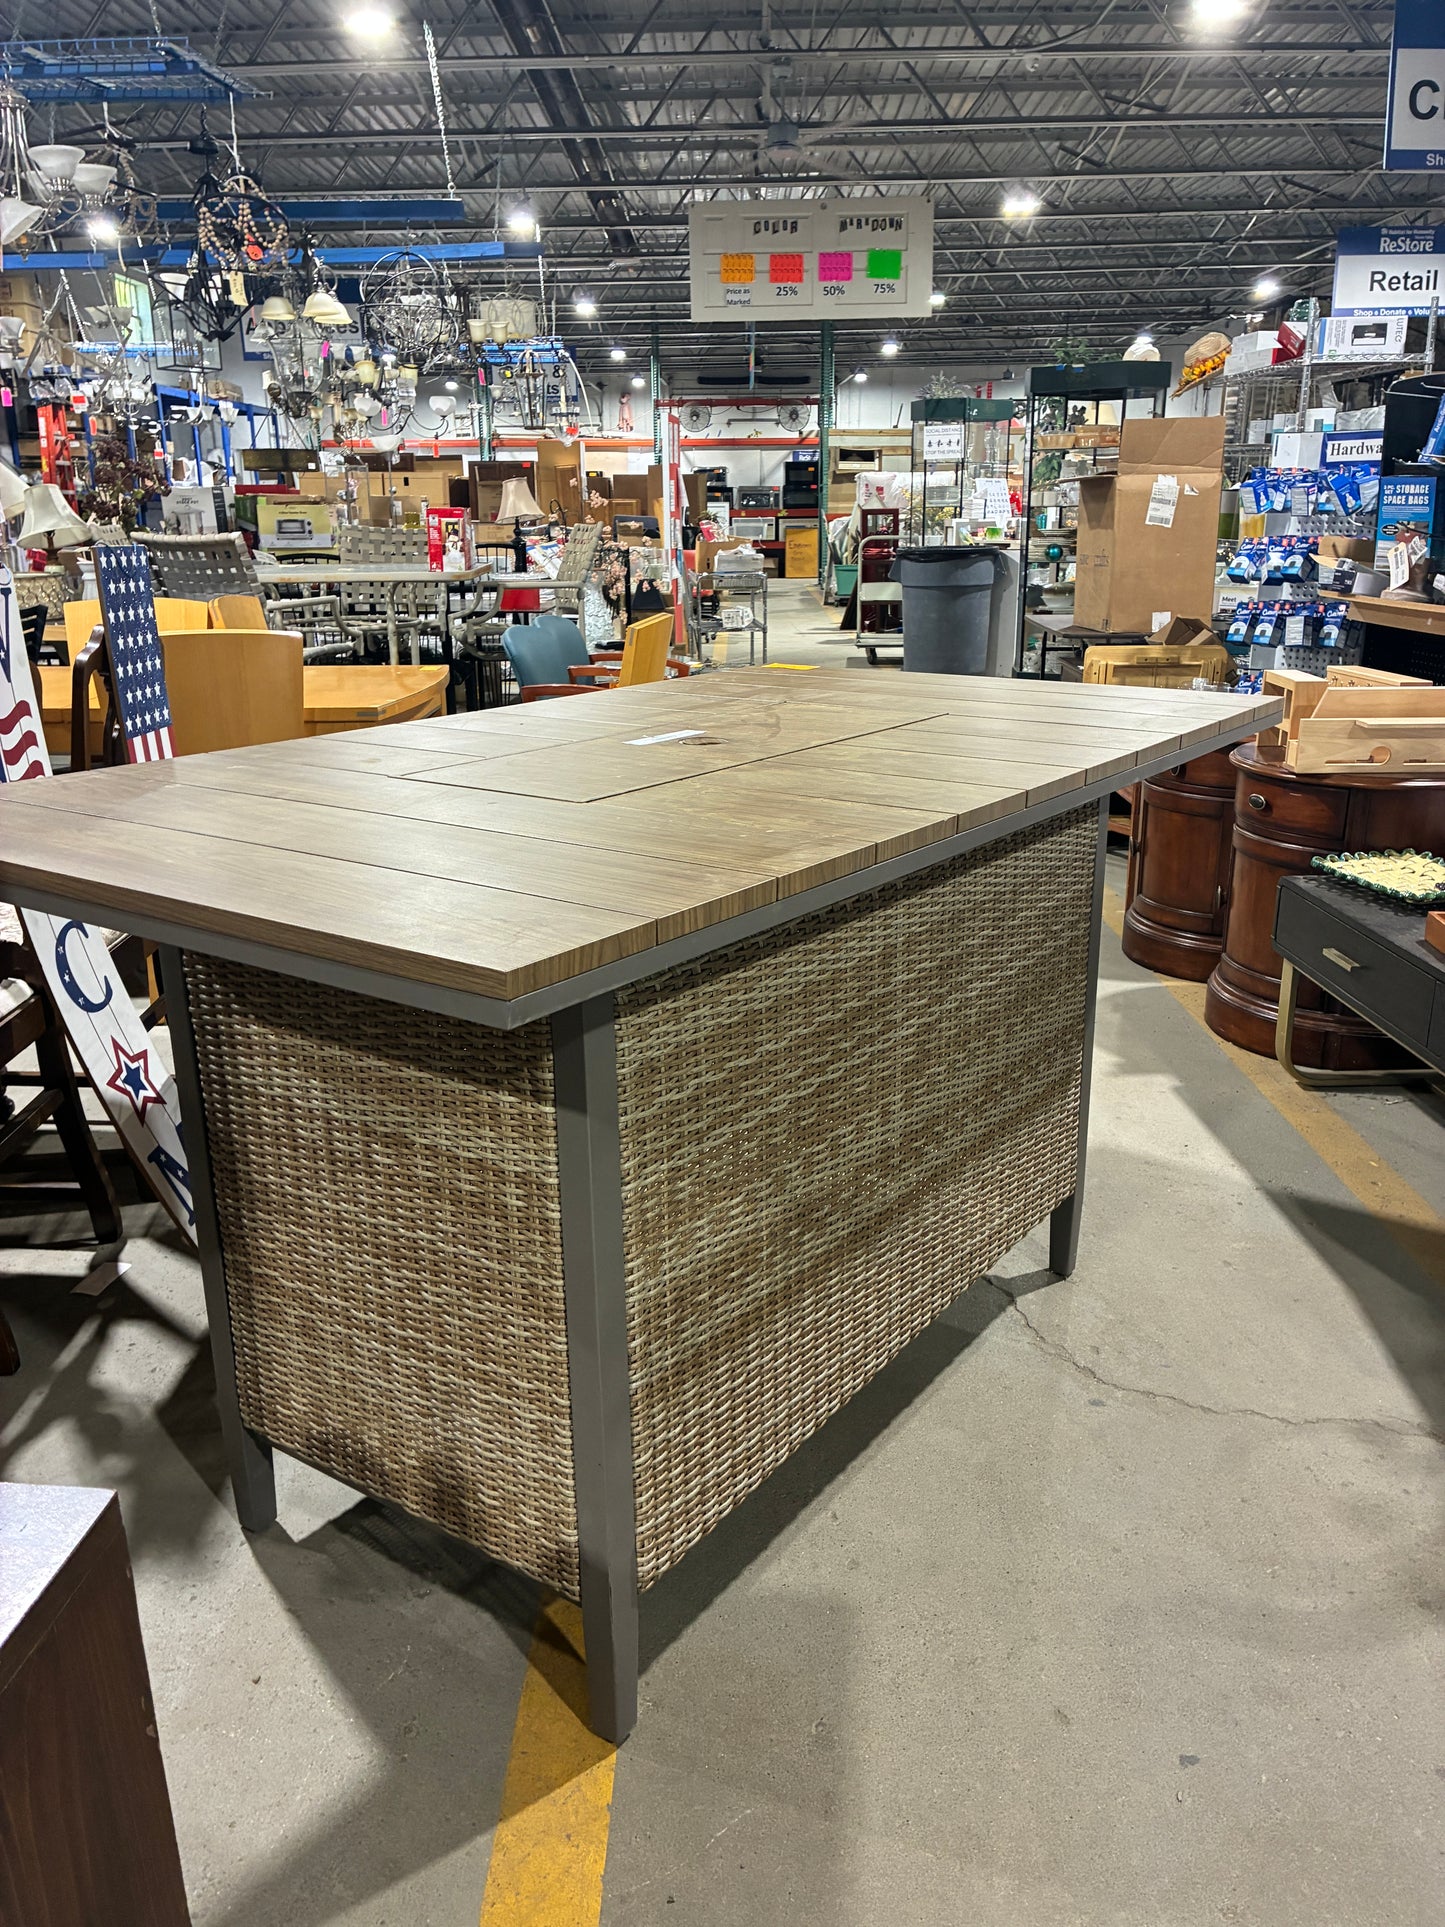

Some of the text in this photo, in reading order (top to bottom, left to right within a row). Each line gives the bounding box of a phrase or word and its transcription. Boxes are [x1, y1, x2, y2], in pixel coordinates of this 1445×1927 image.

[753, 219, 798, 236] COLOR
[1379, 236, 1434, 253] ReStore
[1369, 269, 1439, 292] Retail
[726, 288, 743, 296] Price
[775, 285, 798, 297] 25%
[823, 285, 845, 296] 50%
[874, 283, 896, 294] 75%
[726, 298, 751, 306] Marked
[1353, 308, 1373, 317] Shop
[1380, 308, 1407, 316] Donate
[1396, 484, 1430, 494] STORAGE
[1383, 495, 1429, 505] SPACE BAGS
